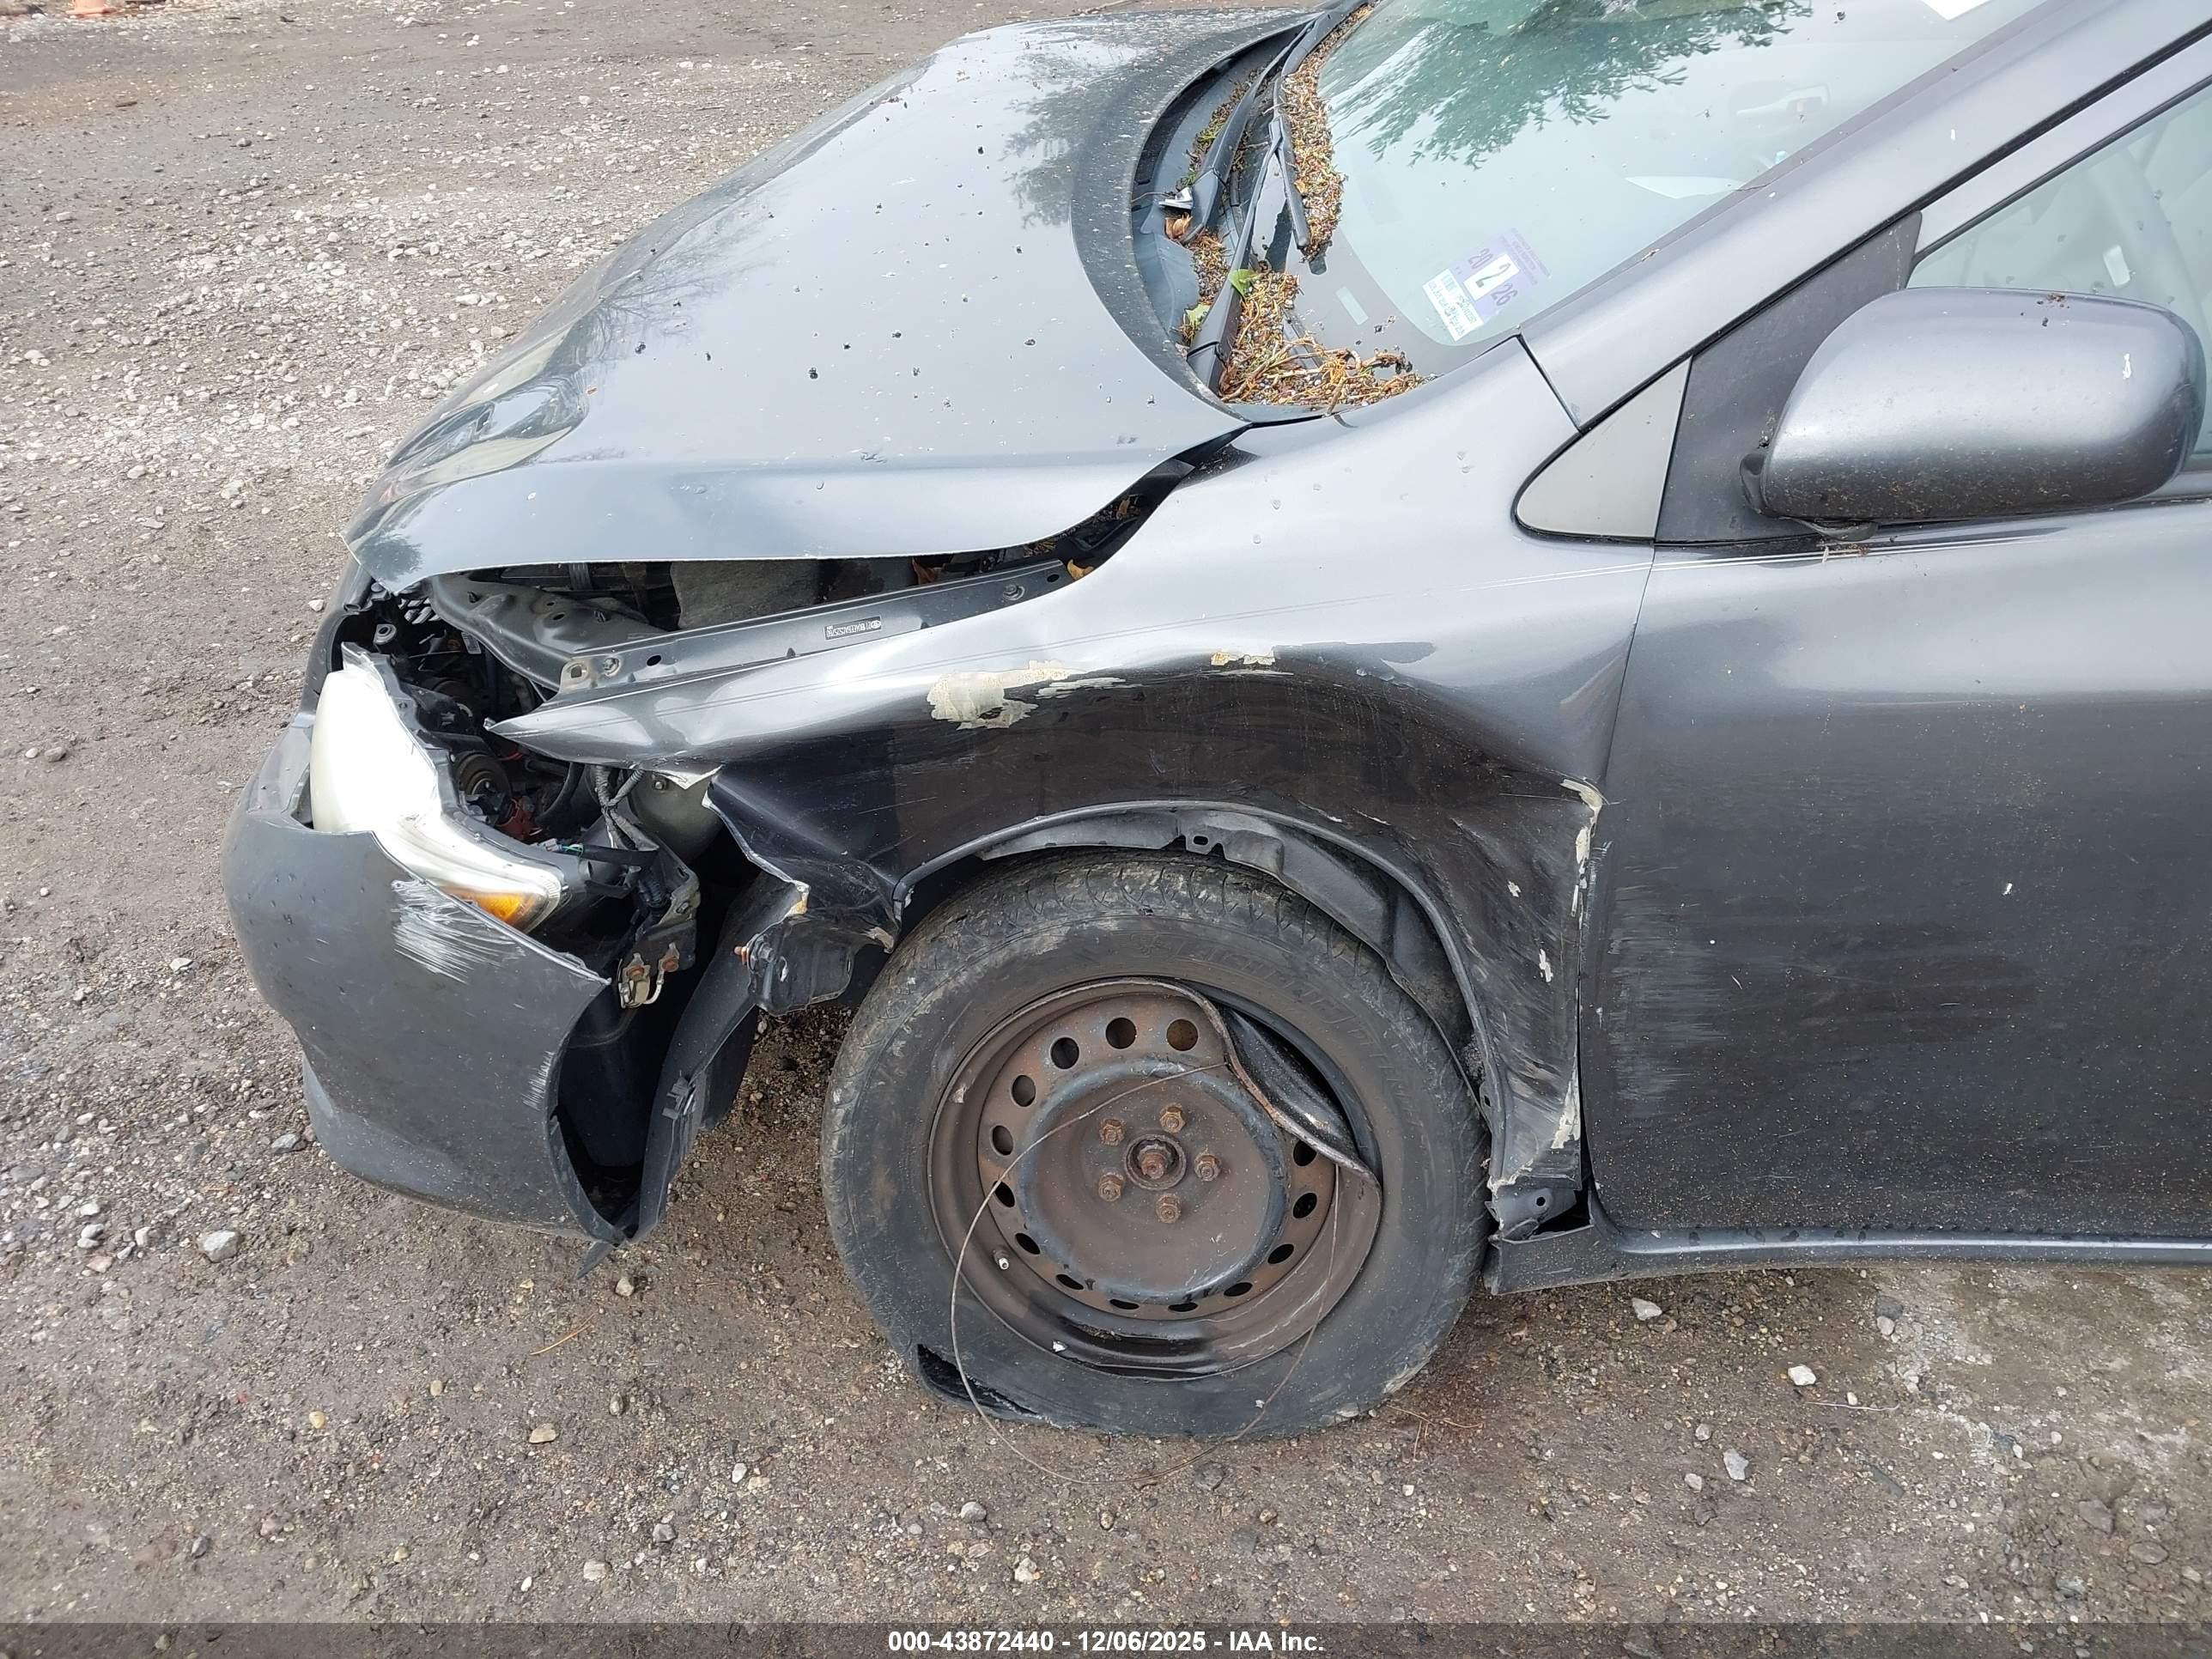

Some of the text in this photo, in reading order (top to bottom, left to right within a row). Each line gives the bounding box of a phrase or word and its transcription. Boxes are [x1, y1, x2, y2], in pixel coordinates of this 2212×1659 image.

[1468, 248, 1517, 306] 20 2 26
